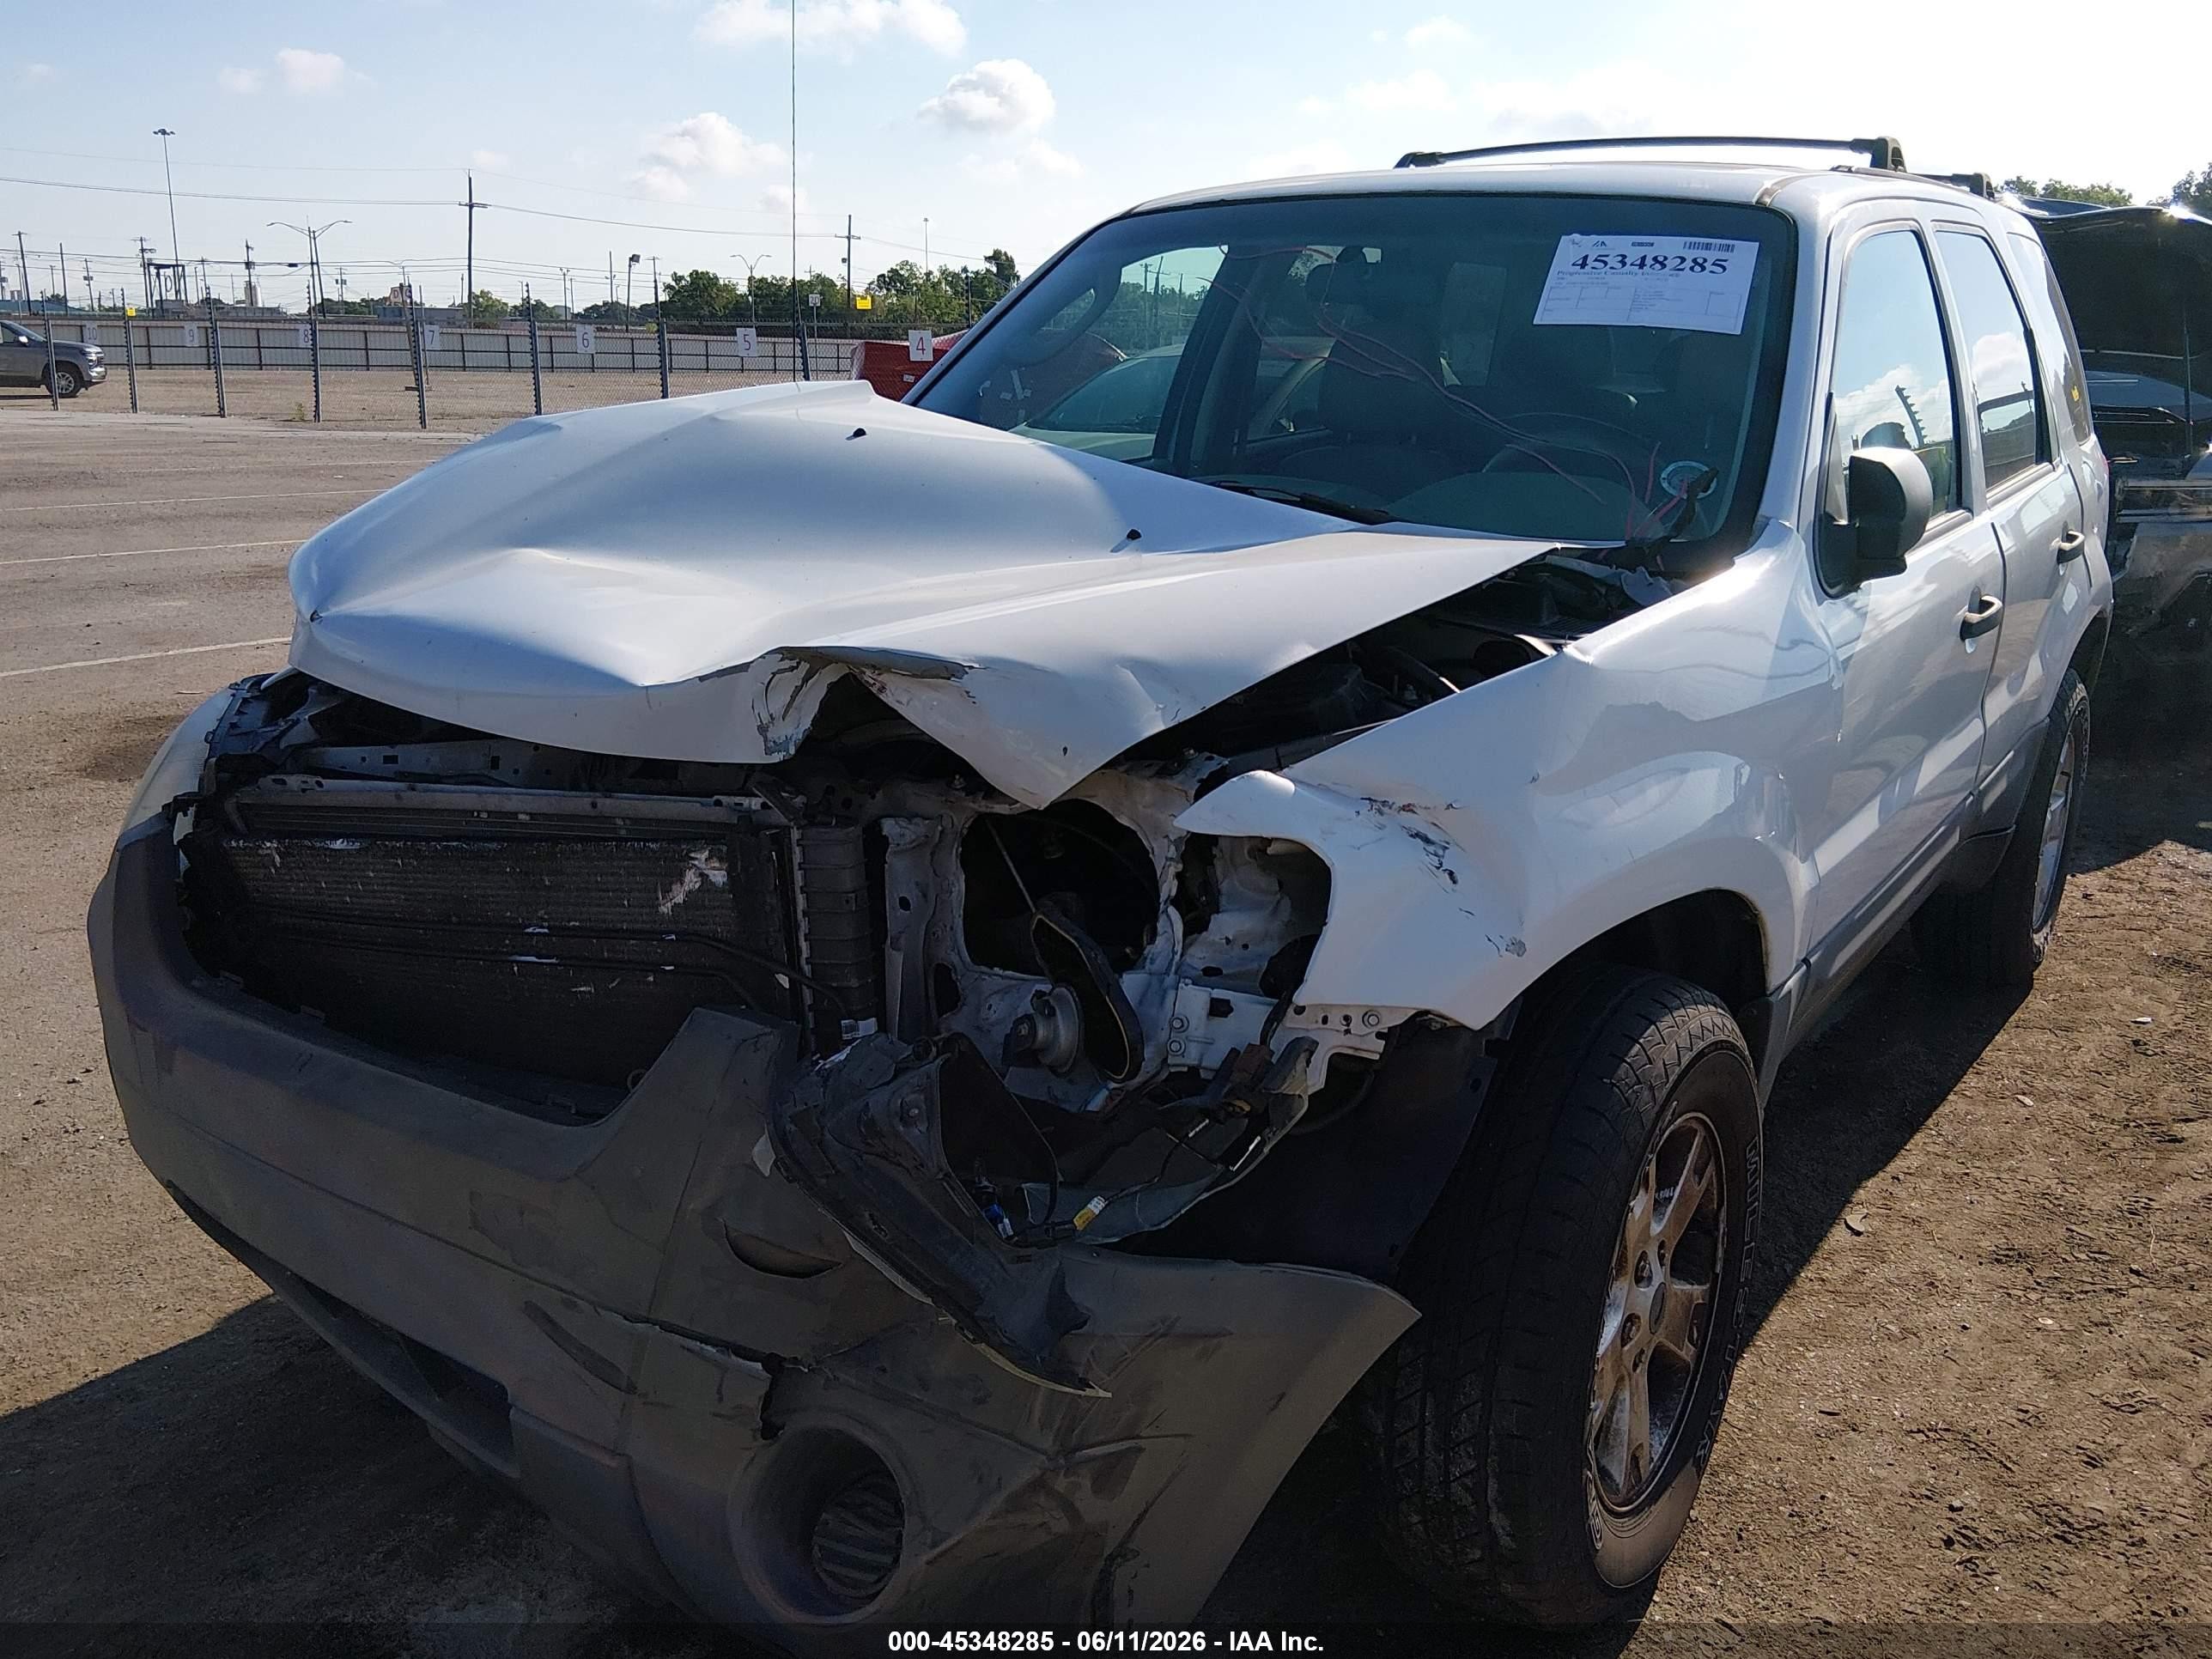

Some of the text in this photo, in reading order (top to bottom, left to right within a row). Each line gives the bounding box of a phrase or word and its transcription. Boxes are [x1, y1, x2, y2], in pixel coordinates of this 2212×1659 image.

[1571, 252, 1729, 275] 45348285
[87, 327, 97, 340] 10
[189, 329, 195, 343] 9
[303, 329, 309, 343] 8
[429, 330, 435, 344] 7
[582, 332, 590, 349] 6
[744, 334, 751, 350] 5
[915, 336, 927, 356] 4
